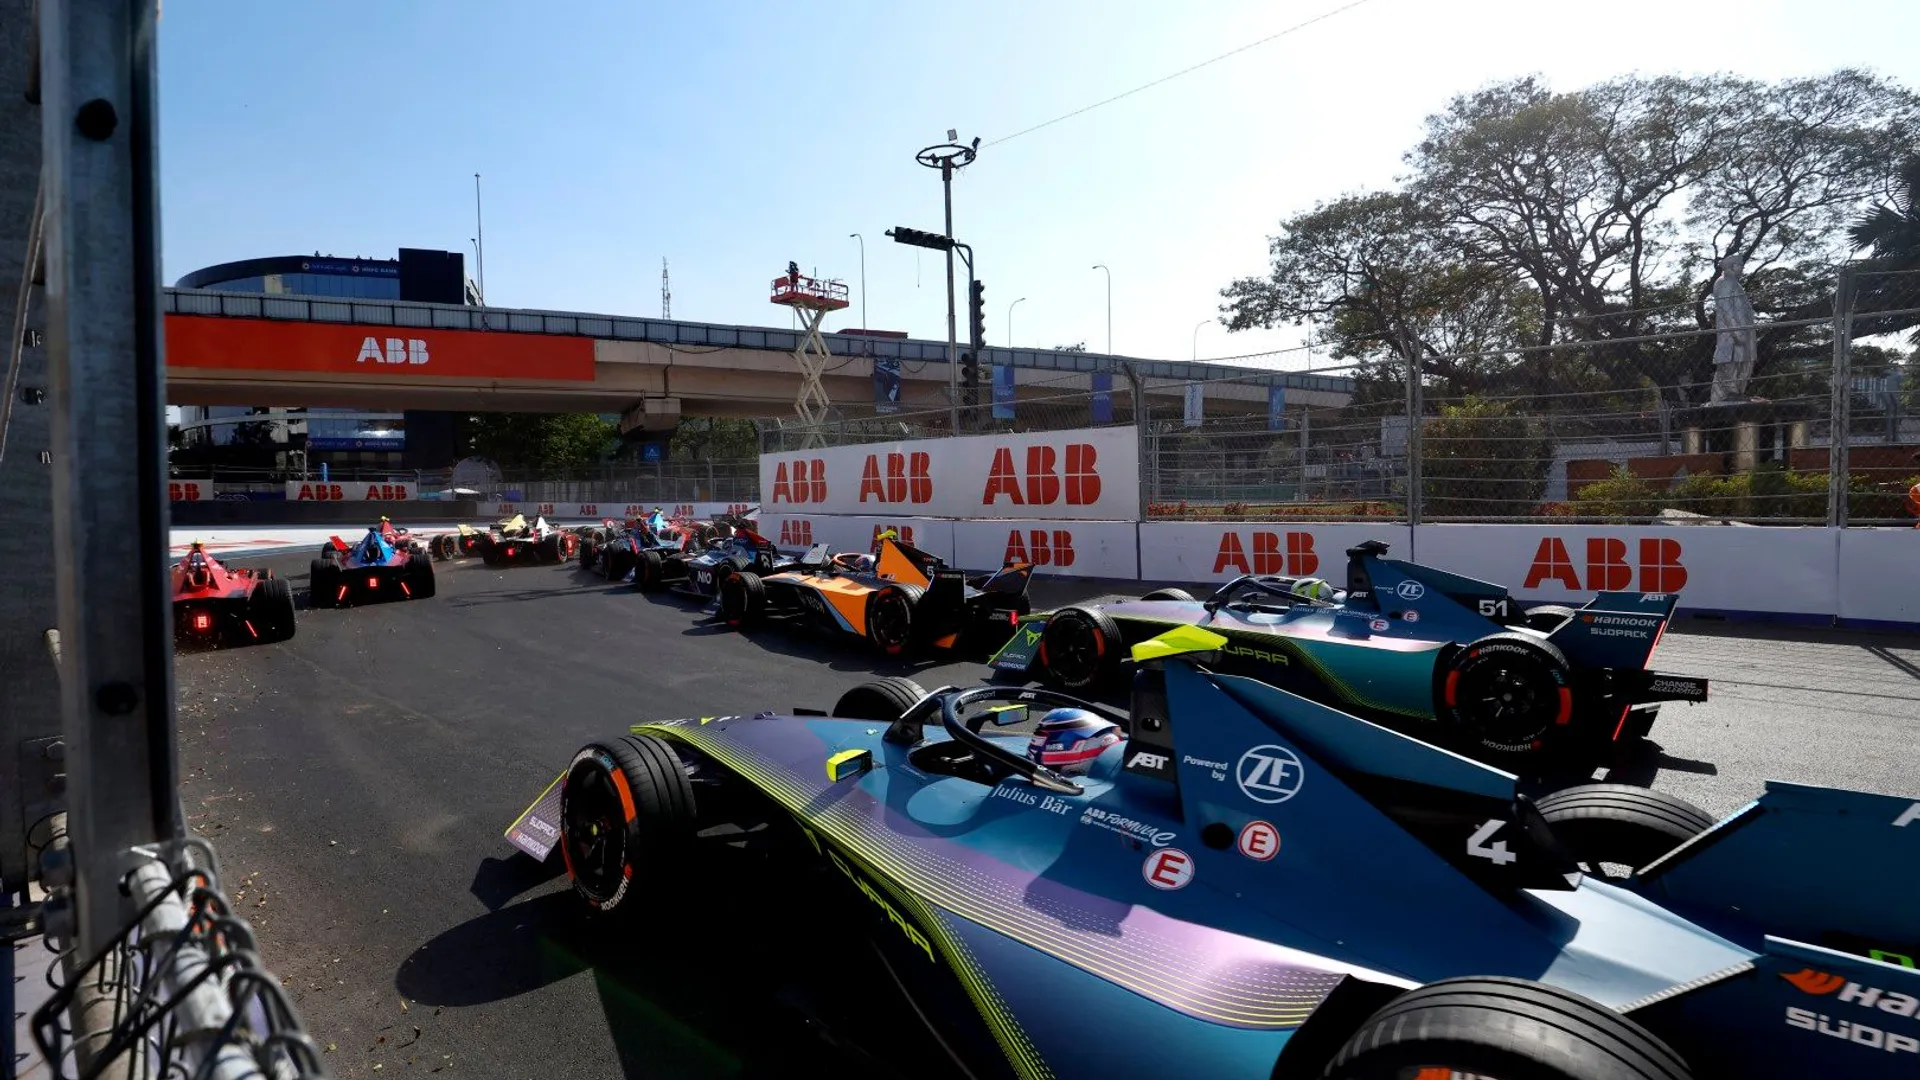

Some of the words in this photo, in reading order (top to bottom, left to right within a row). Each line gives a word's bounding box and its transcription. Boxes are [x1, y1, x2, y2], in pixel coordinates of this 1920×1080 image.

[356, 337, 430, 365] ABB
[772, 458, 827, 503] ABB
[859, 452, 932, 504] ABB
[982, 444, 1102, 505] ABB
[168, 483, 200, 500] BB
[297, 484, 343, 500] ABB
[366, 484, 407, 500] ABB
[580, 504, 597, 516] ABB
[674, 504, 694, 516] ABB
[780, 519, 812, 547] ABB
[1004, 529, 1075, 567] ABB
[1213, 531, 1319, 575] ABB
[1523, 537, 1688, 593] ABB
[1478, 600, 1509, 617] 51
[1639, 593, 1668, 603] ABT
[1224, 644, 1289, 666] UPRA
[1018, 691, 1037, 700] ABT
[1125, 750, 1170, 771] ABT
[1183, 754, 1229, 772] Powered
[1211, 769, 1226, 783] by
[991, 783, 1037, 807] Julius
[1039, 795, 1074, 817] Bär
[1083, 806, 1107, 820] ABB
[1466, 818, 1517, 866] 4
